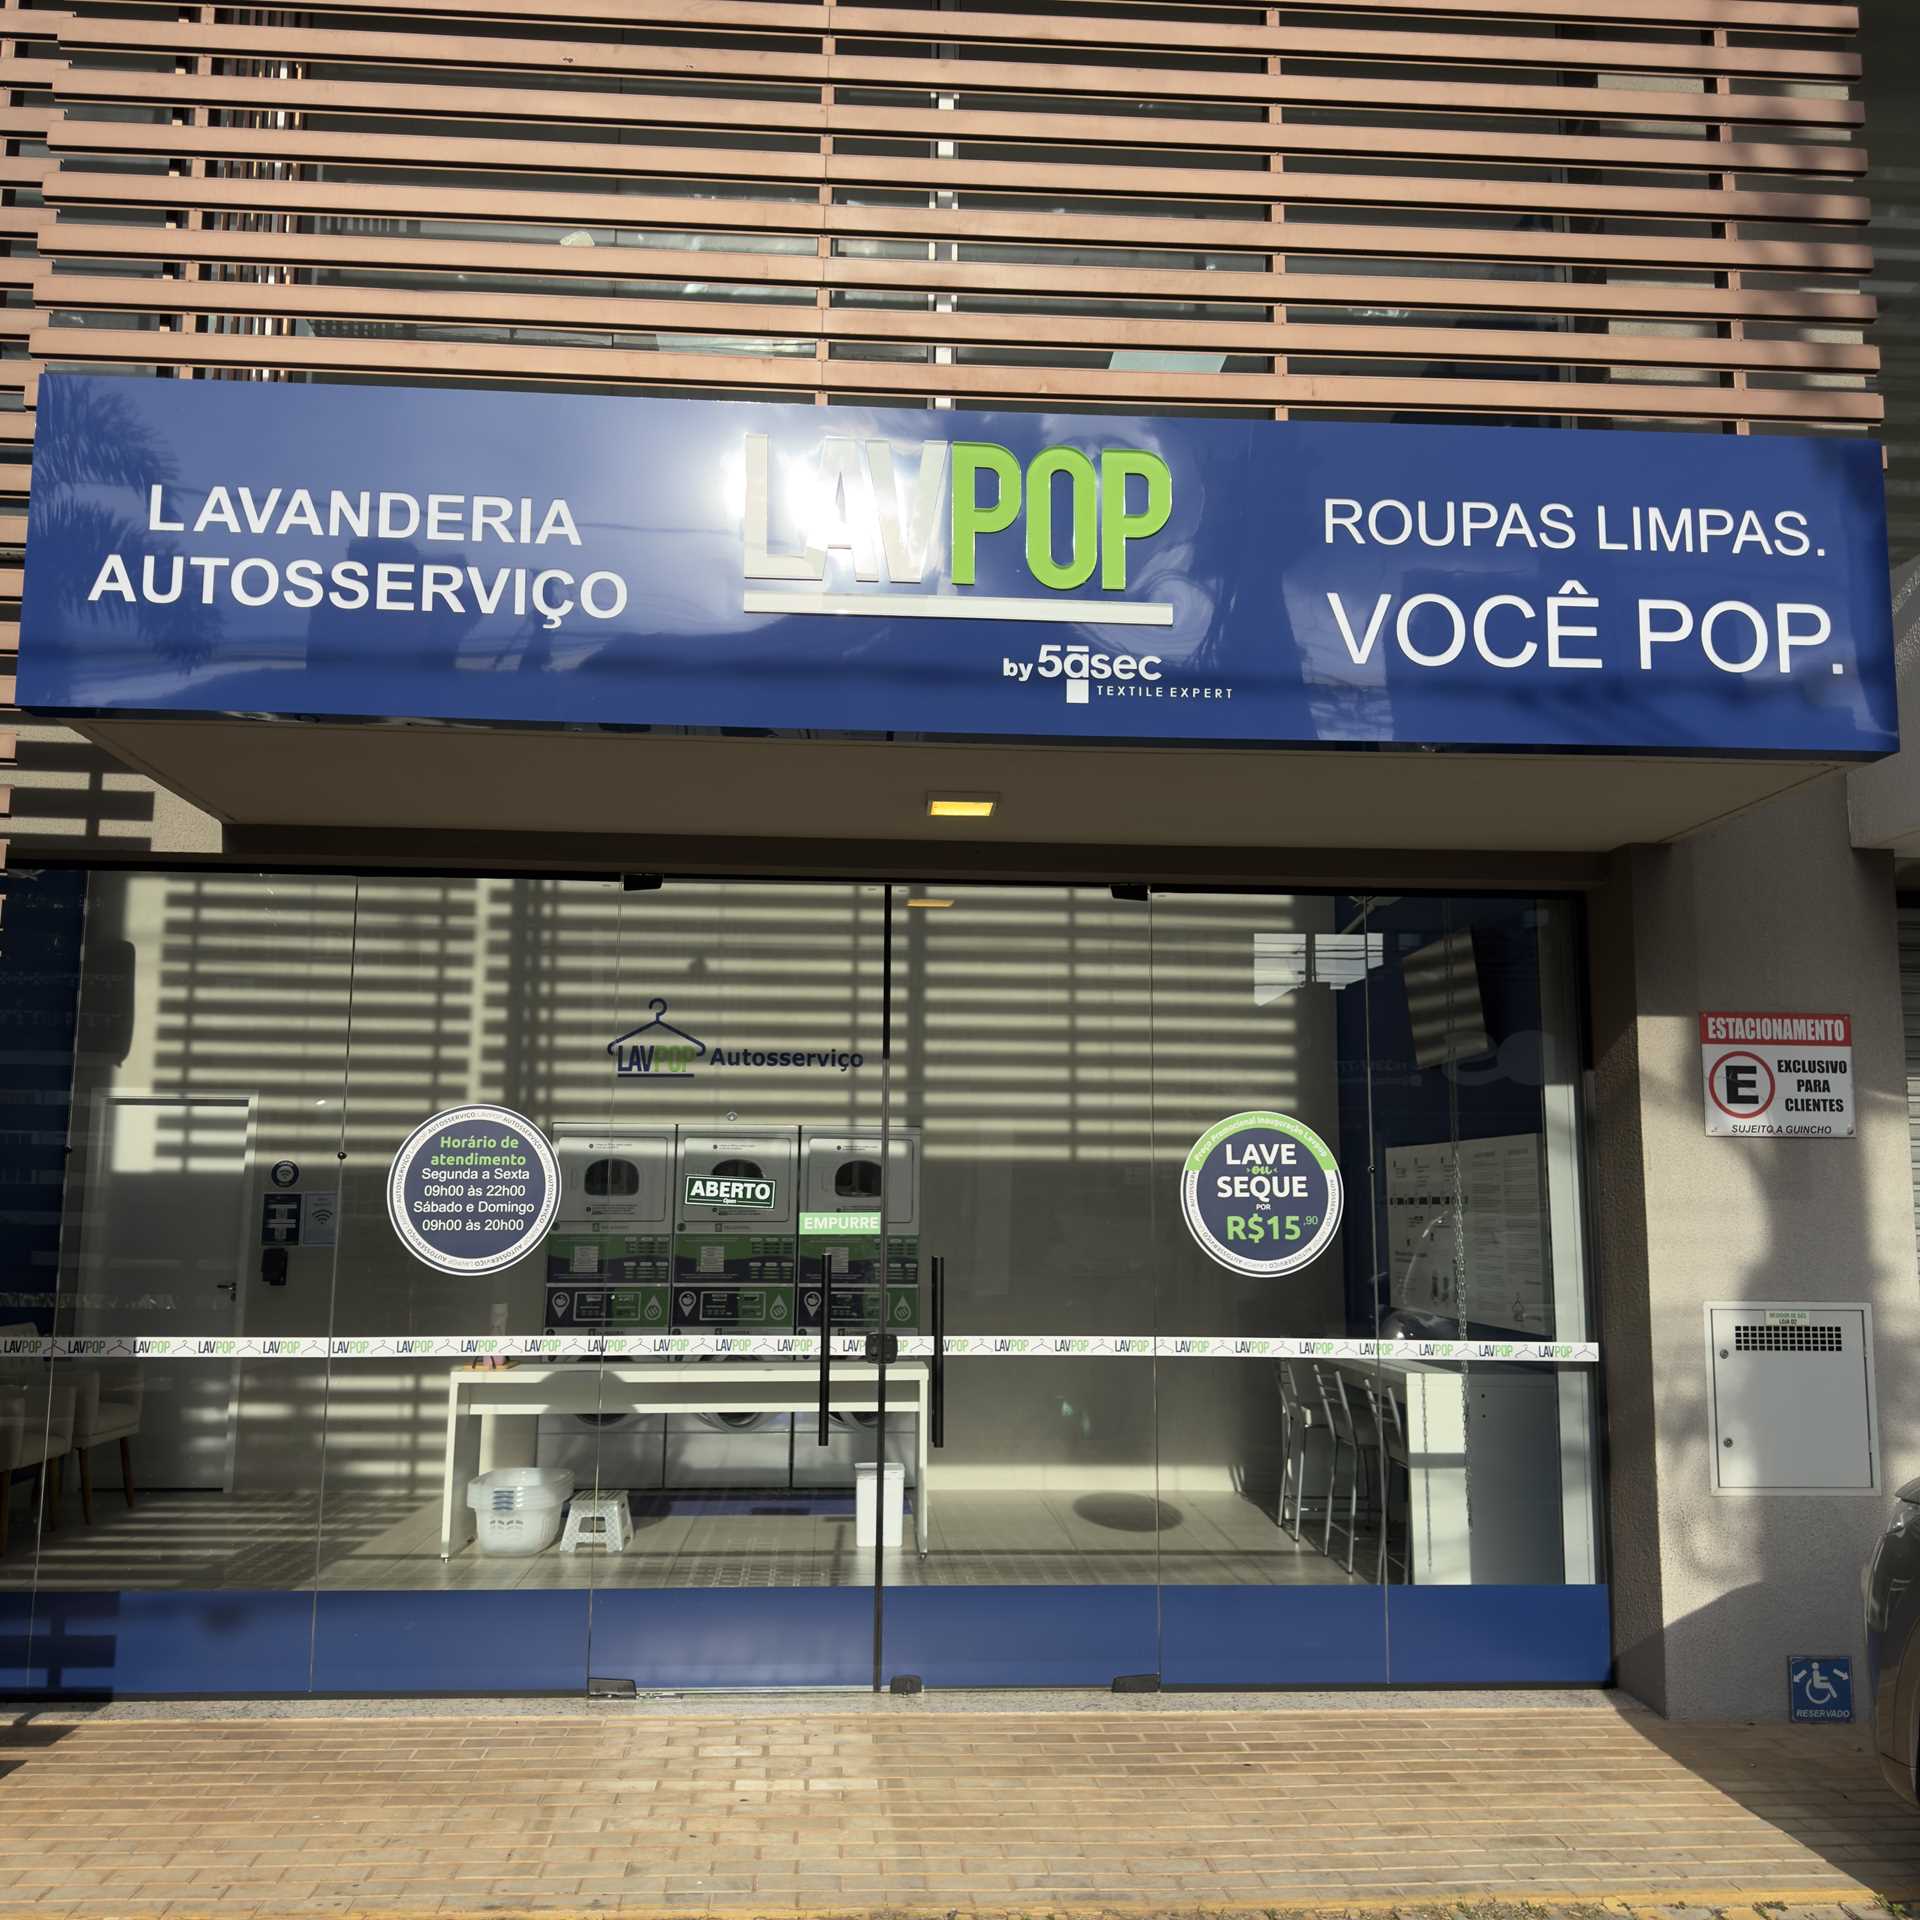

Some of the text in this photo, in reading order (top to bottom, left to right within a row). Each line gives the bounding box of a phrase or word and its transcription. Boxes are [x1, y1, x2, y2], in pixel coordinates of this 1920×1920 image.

[148, 483, 582, 546] LAVANDERIA
[744, 433, 1173, 590] LAVPOP
[1324, 498, 1826, 556] ROUPAS LIMPAS.
[87, 553, 628, 629] AUTOSSERVIÇO
[1326, 579, 1844, 675] VOCÊ POP.
[1003, 657, 1033, 682] by
[1096, 685, 1233, 699] TEXTILE EXPERT
[1707, 1016, 1845, 1041] ESTACIONAMENTO
[617, 1045, 864, 1072] LAVPOP Autosserviço
[1777, 1059, 1847, 1074] EXCLUSIVO
[1725, 1065, 1759, 1104] E
[1797, 1079, 1831, 1093] PARA
[1785, 1098, 1844, 1113] CLIENTES
[1731, 1124, 1832, 1135] SUJEITO A GUINCHO
[440, 1136, 497, 1149] Horário
[500, 1136, 519, 1149] de
[430, 1153, 526, 1166] atendimento
[1225, 1143, 1297, 1165] LAVE
[421, 1168, 530, 1182] Segunda a Sexta
[424, 1185, 525, 1197] 09h00 às 22h00
[690, 1180, 771, 1200] ABERTO
[1216, 1175, 1308, 1202] SEQUE
[413, 1200, 535, 1215] Sábado e Domingo
[1255, 1203, 1271, 1211] POR
[422, 1219, 524, 1231] 09h00 às 20h00
[804, 1216, 879, 1230] EMPURRE
[4, 1340, 42, 1354] LAVPOP
[68, 1340, 105, 1354] LAVPOP
[133, 1340, 171, 1354] LAVPOP
[198, 1340, 235, 1354] LAVPOP
[263, 1340, 300, 1354] LAVPOP
[332, 1340, 369, 1354] LAVPOP
[396, 1340, 433, 1353] LAVPOP
[460, 1340, 497, 1353] LAVPOP
[524, 1340, 561, 1353] LAVPOP
[588, 1339, 627, 1352] LAVPOP
[654, 1339, 690, 1352] LAVPOP
[716, 1339, 752, 1352] LAVPOP
[777, 1339, 812, 1352] LAVPOP
[995, 1339, 1030, 1352] LAVPOP
[1054, 1339, 1089, 1352] LAVPOP
[1114, 1339, 1150, 1352] LAVPOP
[1175, 1340, 1210, 1353] LAVPOP
[1235, 1340, 1270, 1354] LAVPOP
[1300, 1342, 1334, 1354] LAVPOP
[1360, 1342, 1393, 1356] LAVPOP
[1419, 1344, 1454, 1356] LAVPOP
[1478, 1344, 1513, 1357] LAVPOP
[1538, 1345, 1572, 1358] LAVPOP
[1796, 1709, 1850, 1718] RESERVADO
